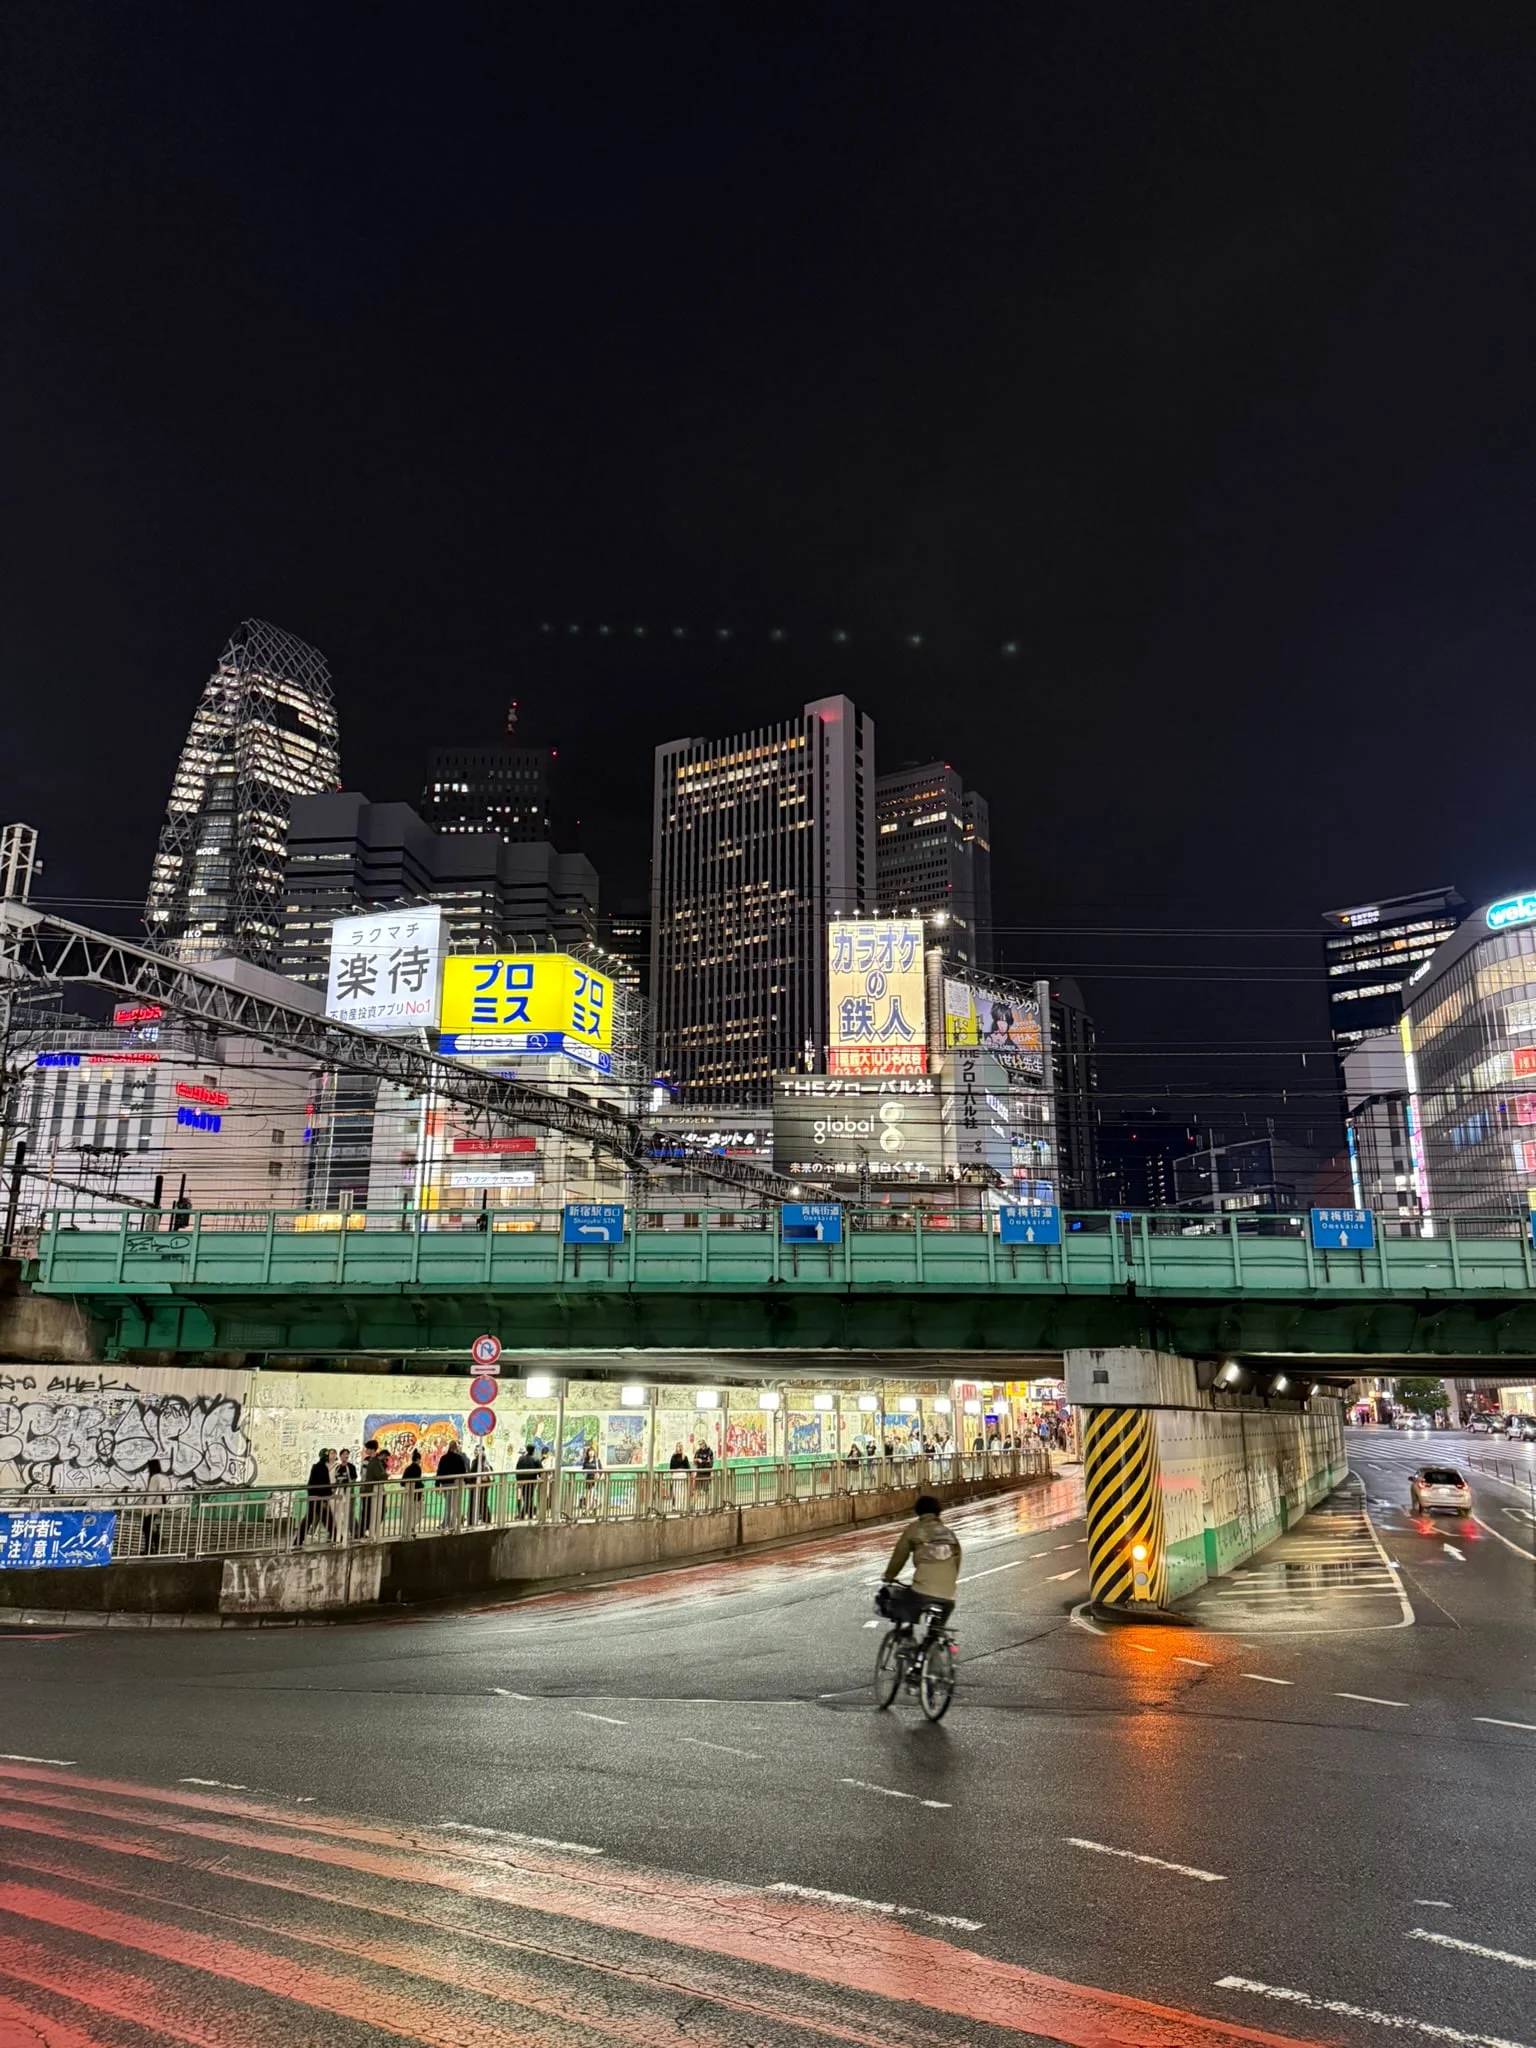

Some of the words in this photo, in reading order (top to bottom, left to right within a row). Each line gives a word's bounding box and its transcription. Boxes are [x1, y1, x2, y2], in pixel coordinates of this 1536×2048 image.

[196, 847, 220, 856] MODE
[188, 888, 207, 896] HAL
[352, 923, 419, 945] ラクマチ
[833, 925, 921, 973] カラオケ
[336, 946, 430, 1000] 楽待
[473, 960, 534, 991] プロ
[867, 970, 886, 1000] の
[573, 969, 604, 1008] プロ
[471, 997, 531, 1023] ミス
[572, 1002, 601, 1040] ミス
[839, 997, 915, 1041] 鉄人
[780, 1079, 935, 1098] THEグローバル社
[813, 1114, 875, 1144] global
[802, 1206, 839, 1216] 青梅街道
[1007, 1207, 1053, 1218] 青梅街道
[1319, 1211, 1366, 1222] 青梅街道
[11, 1519, 63, 1538] 歩行者に
